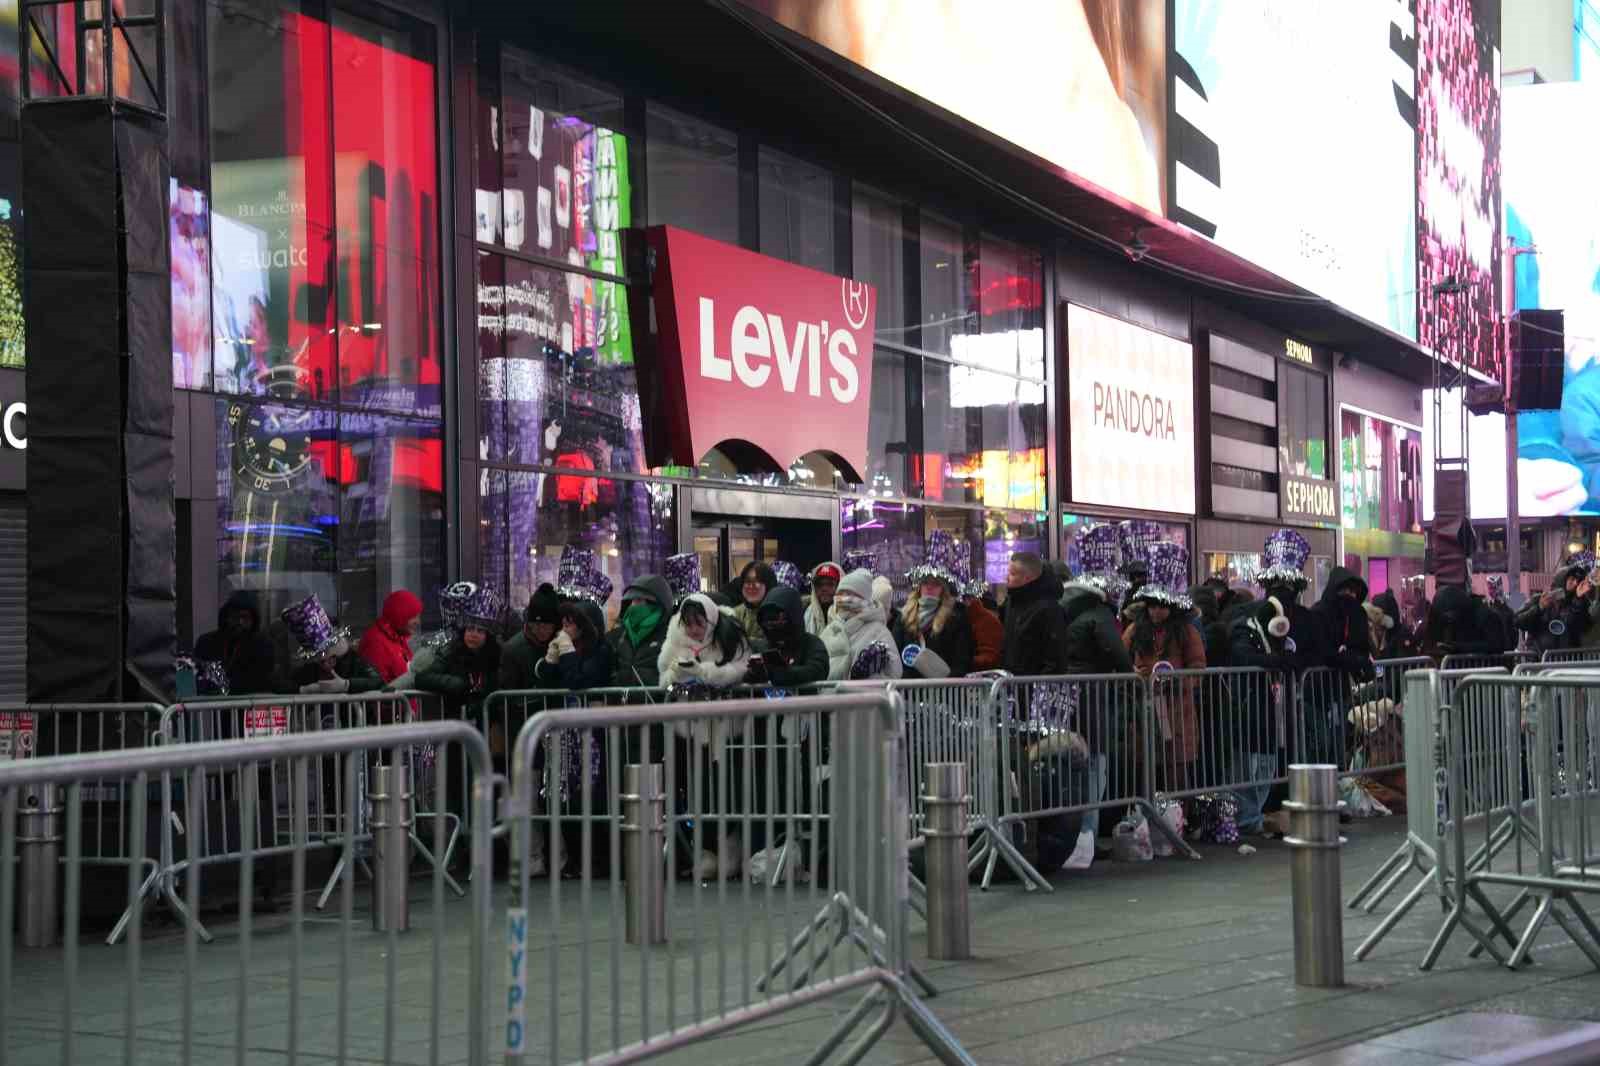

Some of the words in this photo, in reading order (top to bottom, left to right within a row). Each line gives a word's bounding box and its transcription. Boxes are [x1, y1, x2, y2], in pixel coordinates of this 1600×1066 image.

[1286, 338, 1313, 364] SEPHORA
[1093, 381, 1176, 441] PANDORA
[1286, 480, 1336, 517] SEPHORA
[1436, 772, 1446, 836] NYPD
[507, 916, 525, 1048] NYPD
